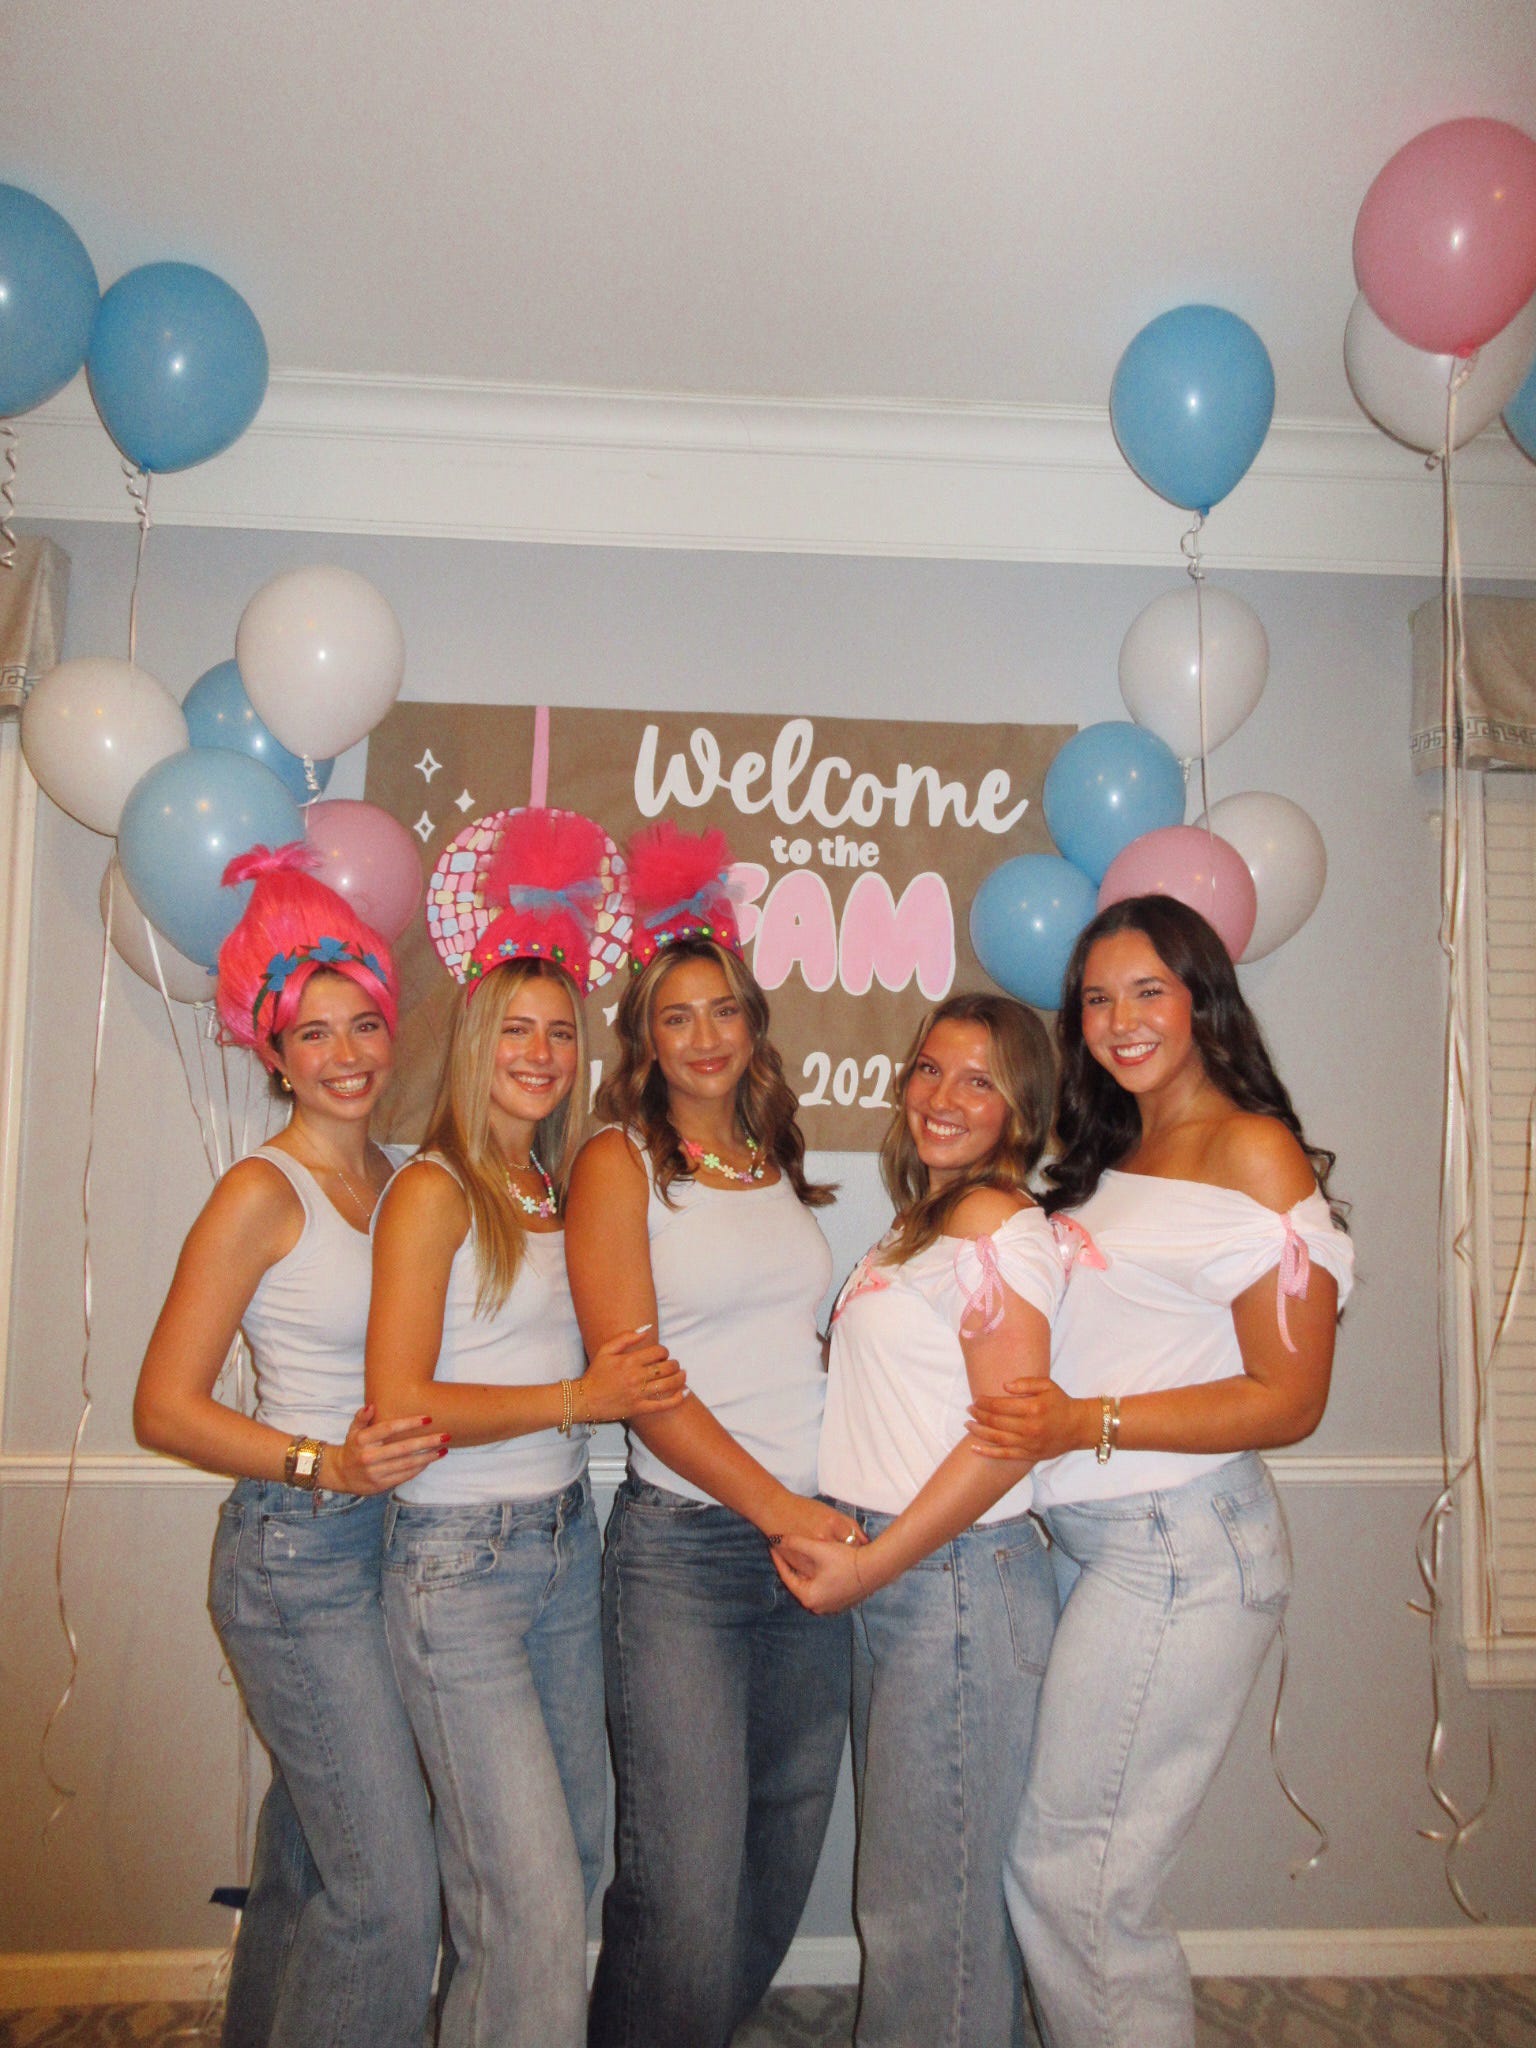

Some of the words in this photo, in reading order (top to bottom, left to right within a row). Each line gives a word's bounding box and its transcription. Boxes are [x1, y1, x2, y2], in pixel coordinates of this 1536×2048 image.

[634, 719, 1029, 834] Welcome
[770, 835, 812, 864] to
[818, 835, 880, 867] the
[798, 1051, 905, 1110] 202
